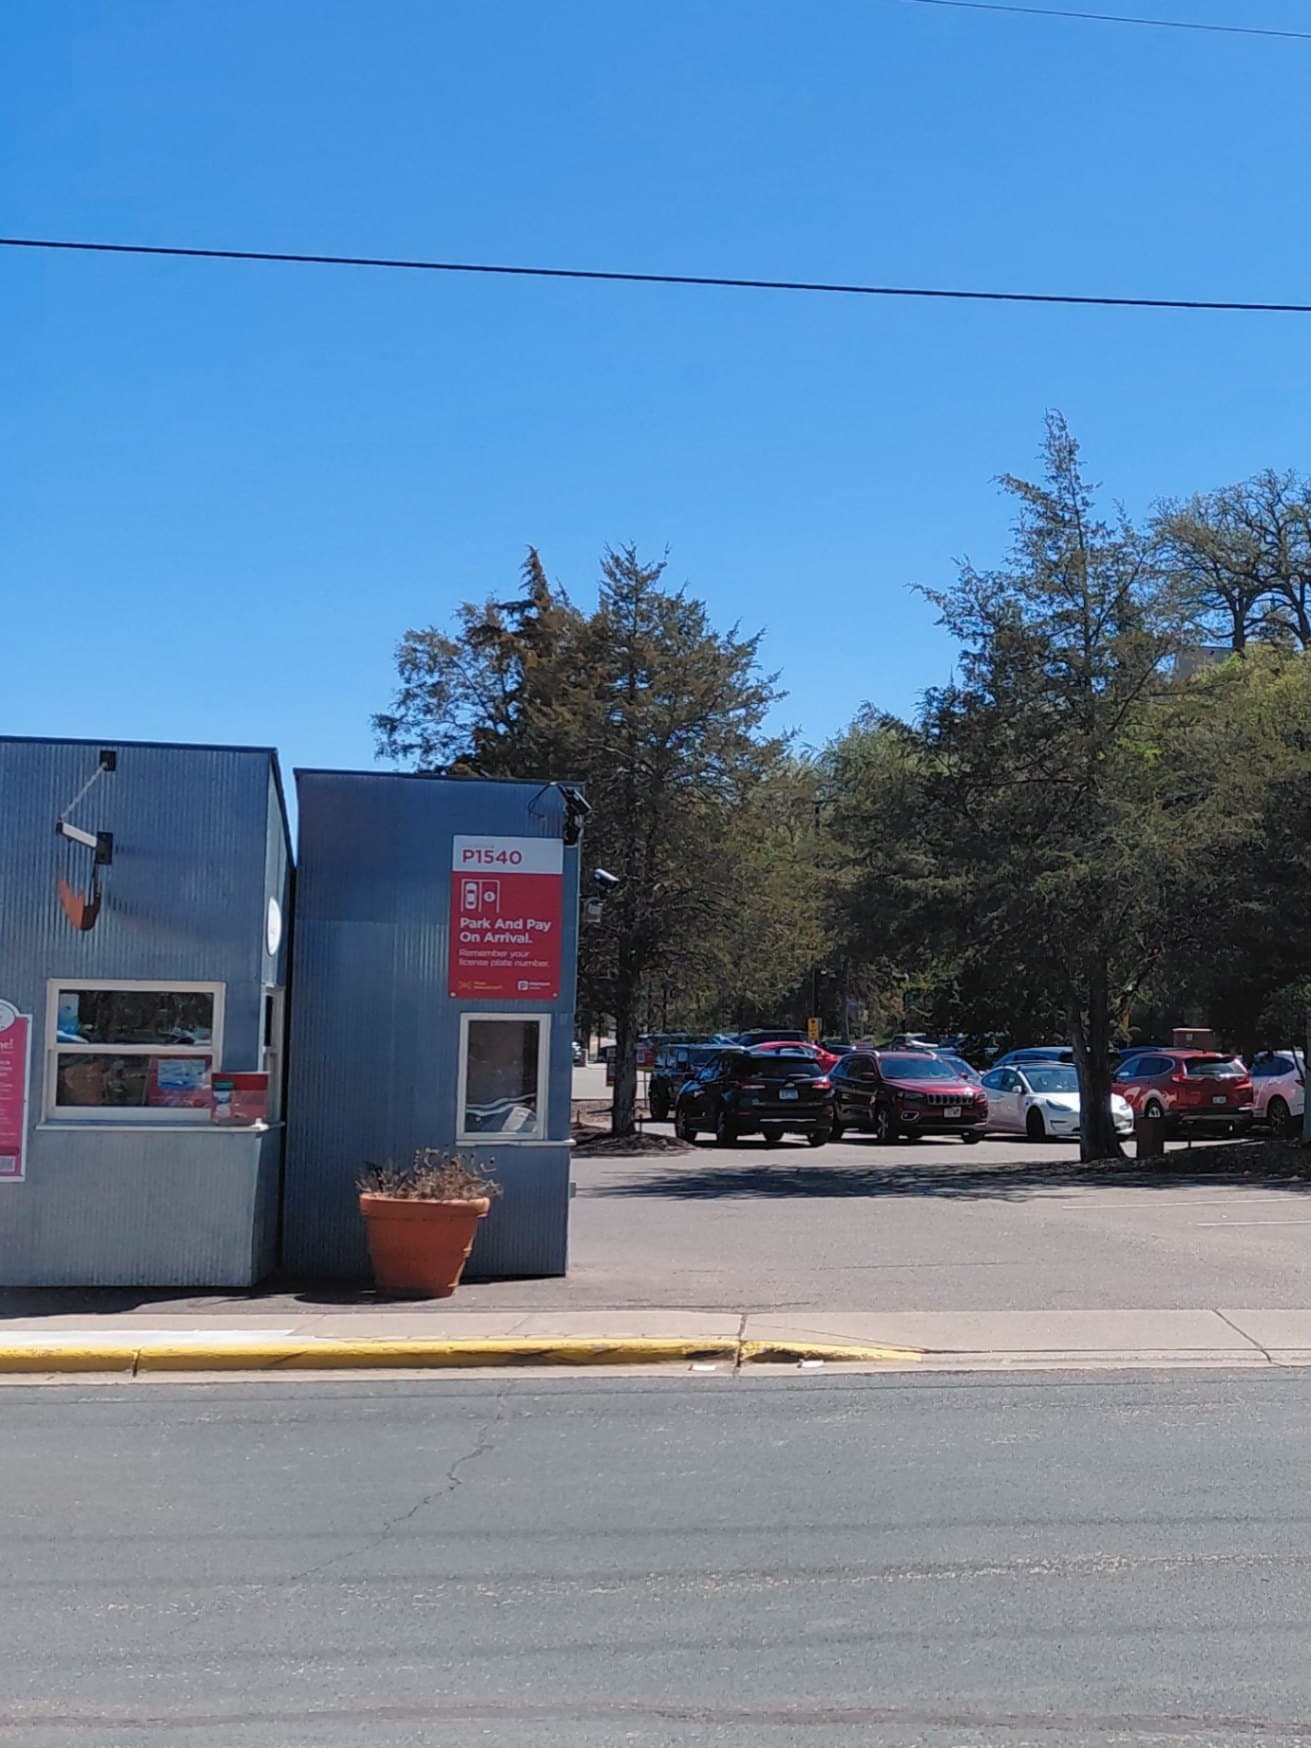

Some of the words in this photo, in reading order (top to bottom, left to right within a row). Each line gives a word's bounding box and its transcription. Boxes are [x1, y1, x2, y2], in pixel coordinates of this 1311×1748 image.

[462, 850, 522, 864] P1540
[460, 917, 491, 929] Park
[495, 918, 523, 930] And
[527, 919, 551, 932] Pay
[460, 931, 480, 942] On
[484, 932, 533, 943] Arrival.
